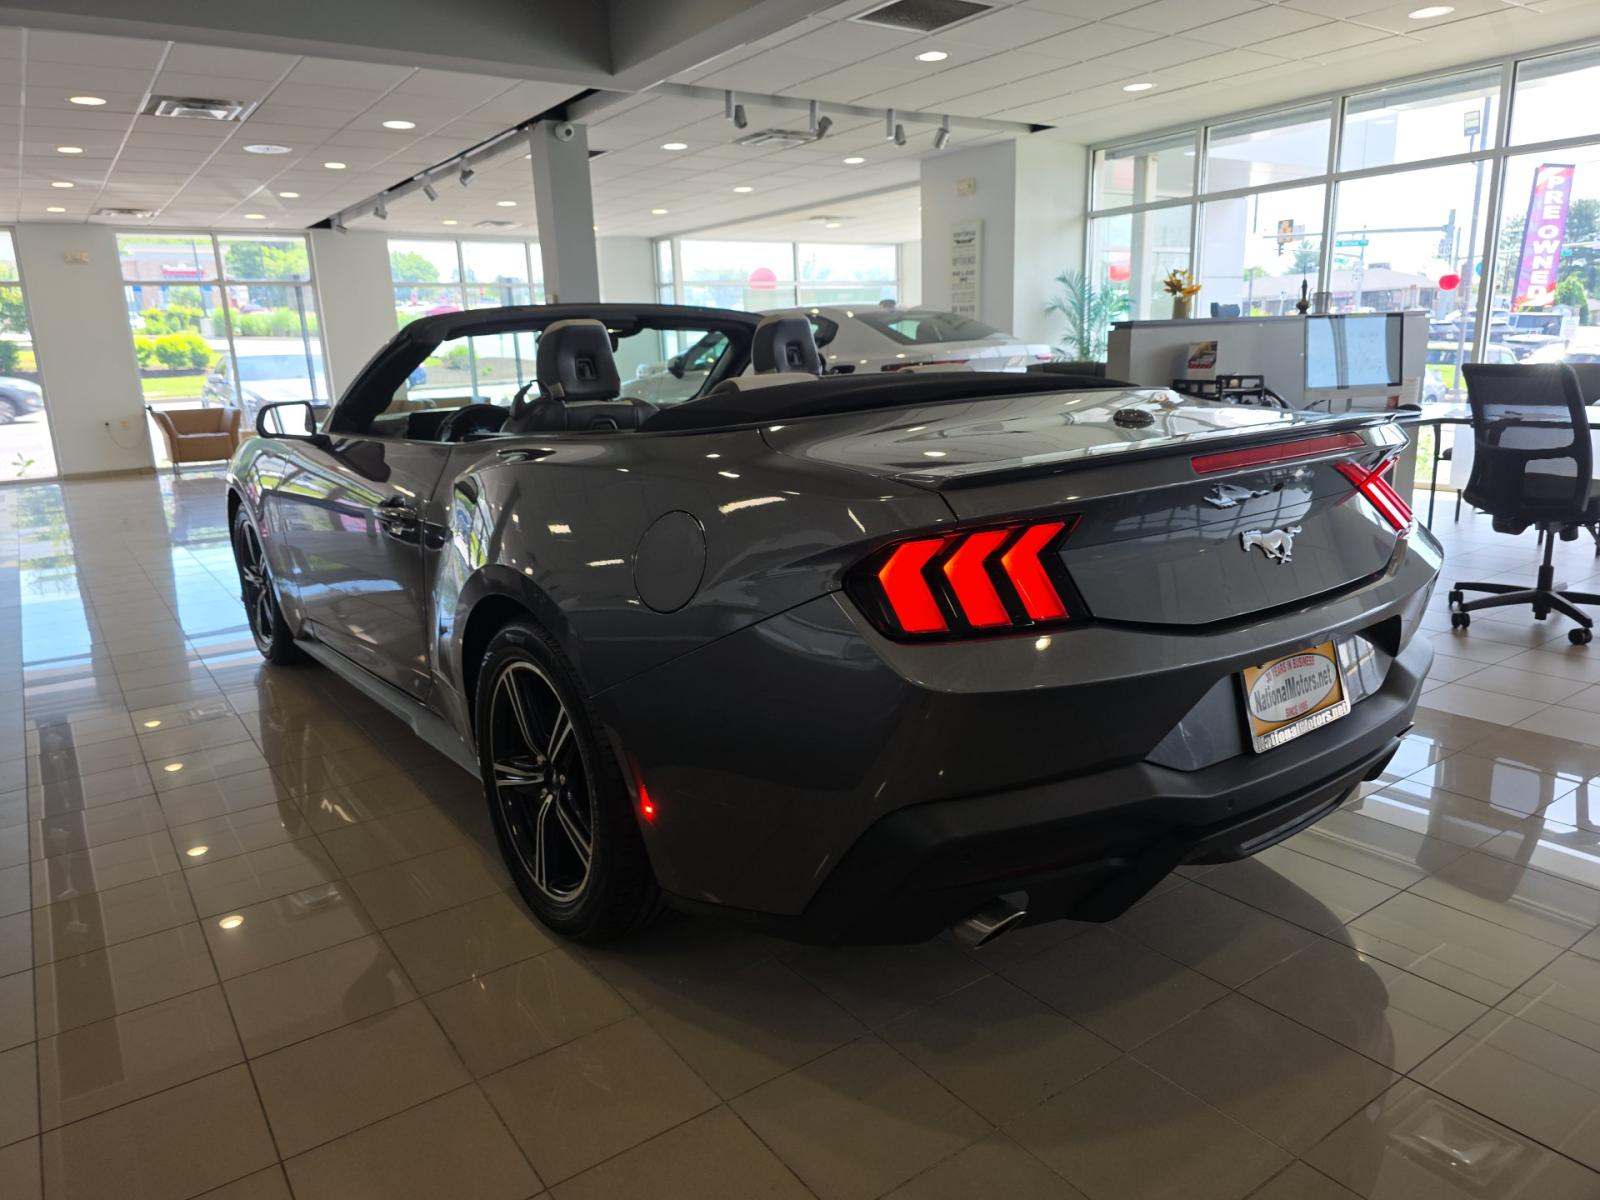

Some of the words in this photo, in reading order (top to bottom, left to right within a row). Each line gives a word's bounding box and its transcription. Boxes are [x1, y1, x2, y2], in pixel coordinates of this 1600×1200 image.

[1542, 175, 1565, 220] PRE
[1254, 664, 1332, 713] NationalMotors.net
[1272, 662, 1286, 677] YEARS
[1293, 655, 1315, 669] BUSINESS
[1256, 702, 1348, 752] NationalMotors.net
